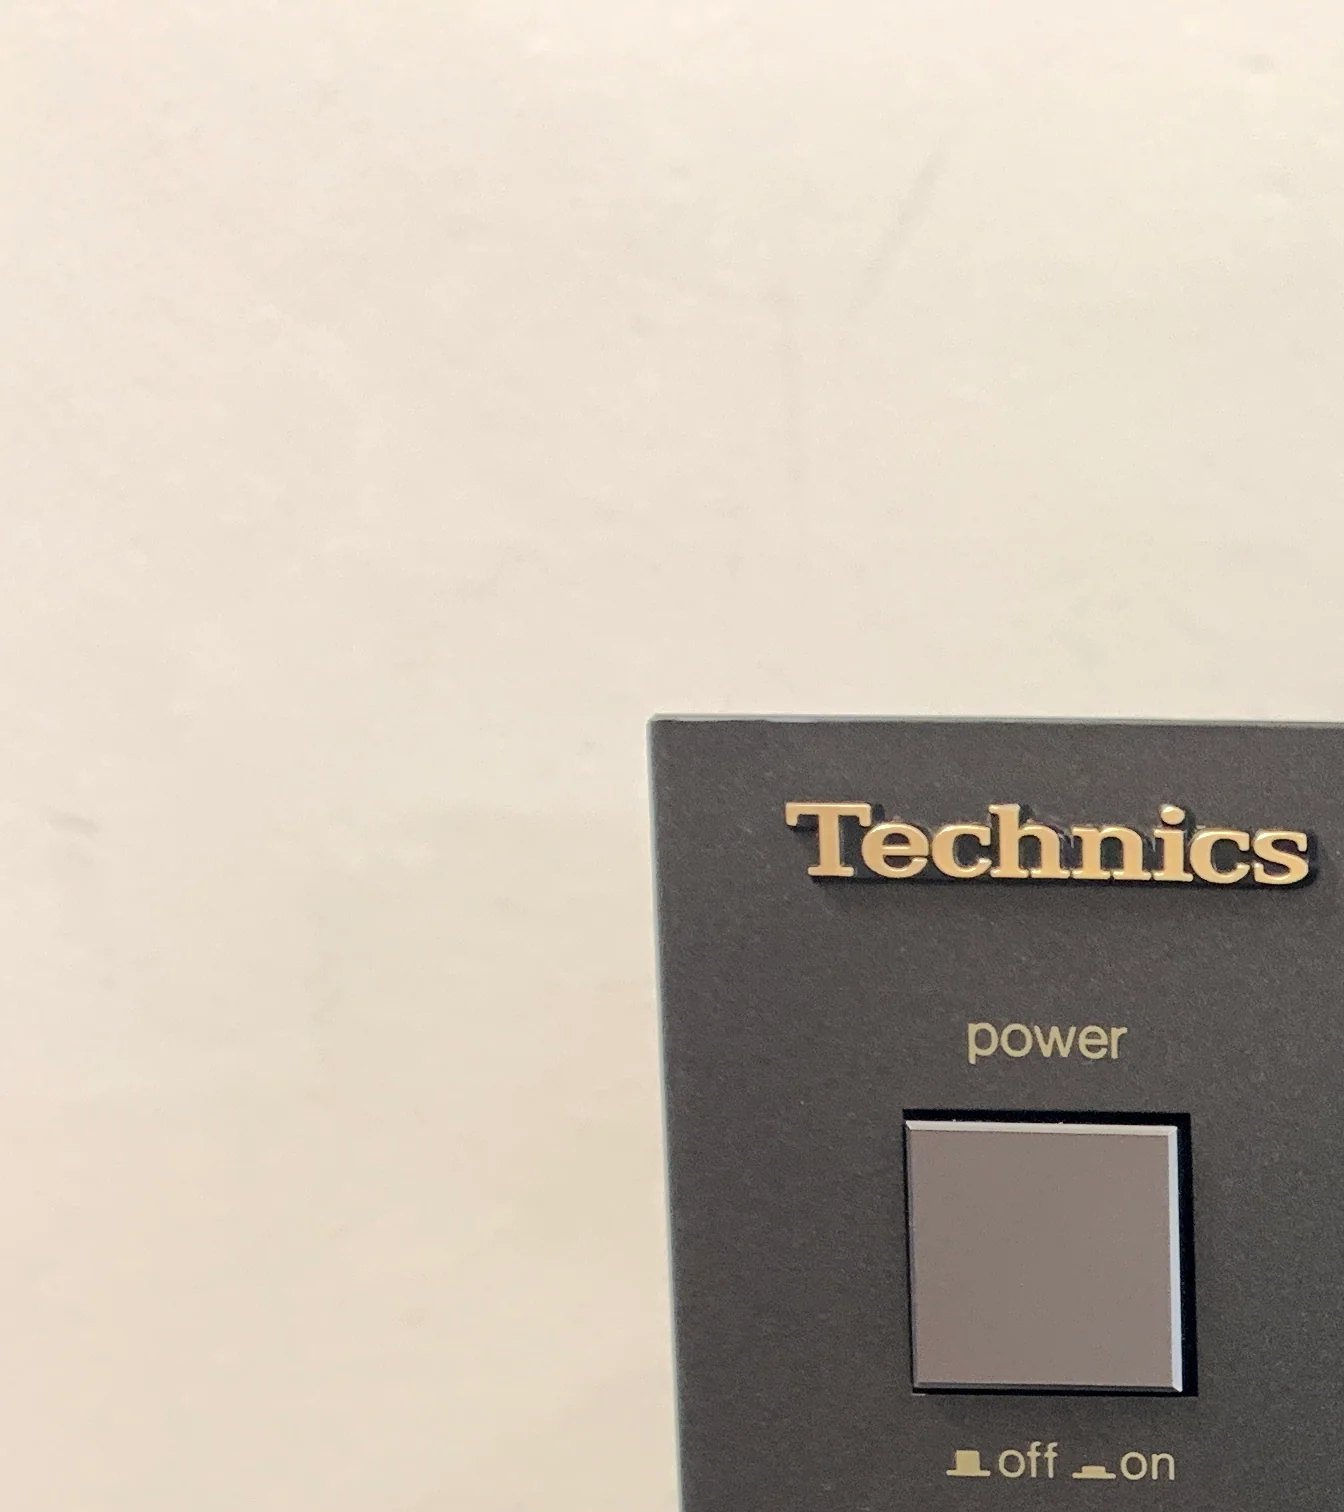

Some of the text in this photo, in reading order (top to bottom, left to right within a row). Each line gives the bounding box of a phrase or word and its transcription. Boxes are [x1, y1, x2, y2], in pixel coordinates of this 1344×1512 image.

[784, 802, 1311, 886] Technics
[968, 1023, 1127, 1064] power
[999, 1441, 1175, 1480] off on
